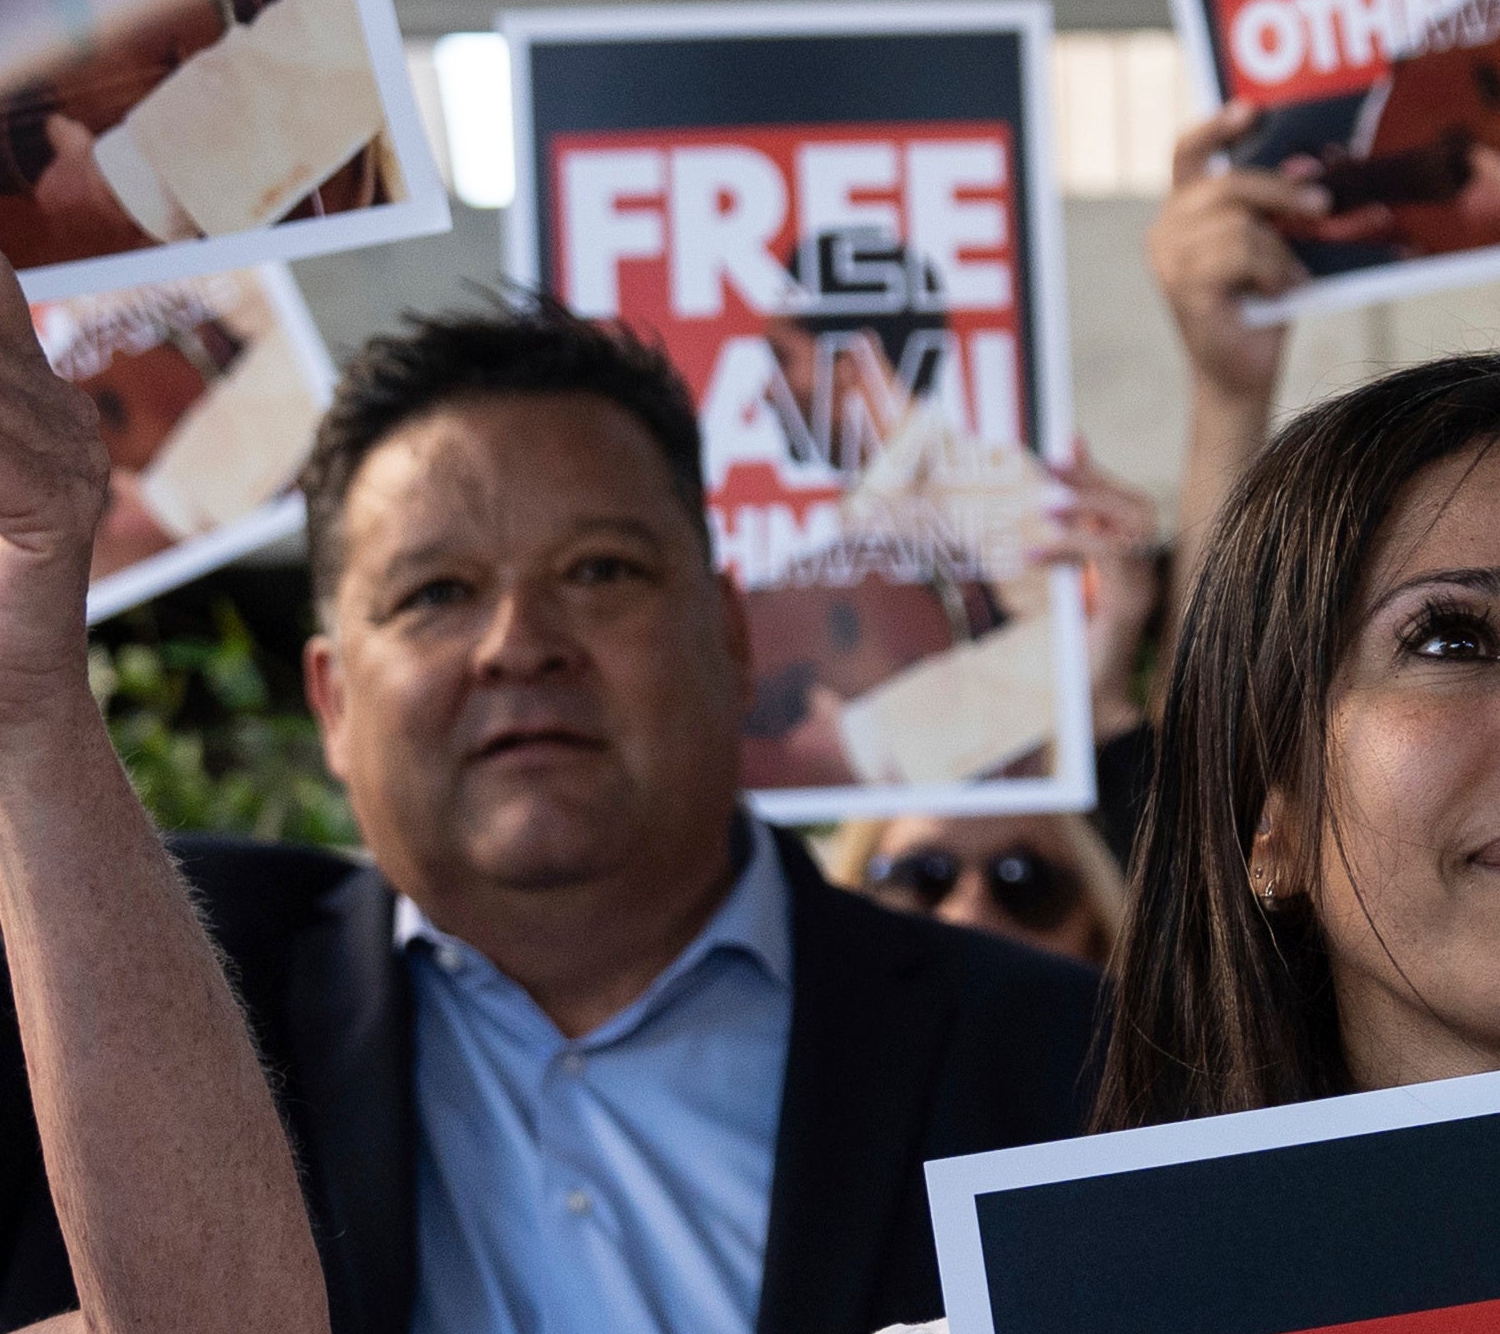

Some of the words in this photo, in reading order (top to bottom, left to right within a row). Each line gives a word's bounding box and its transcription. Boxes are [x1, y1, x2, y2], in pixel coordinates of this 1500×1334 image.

[560, 138, 1011, 320] FREE
[700, 328, 1025, 493] AMI
[707, 499, 1022, 595] HMANE
